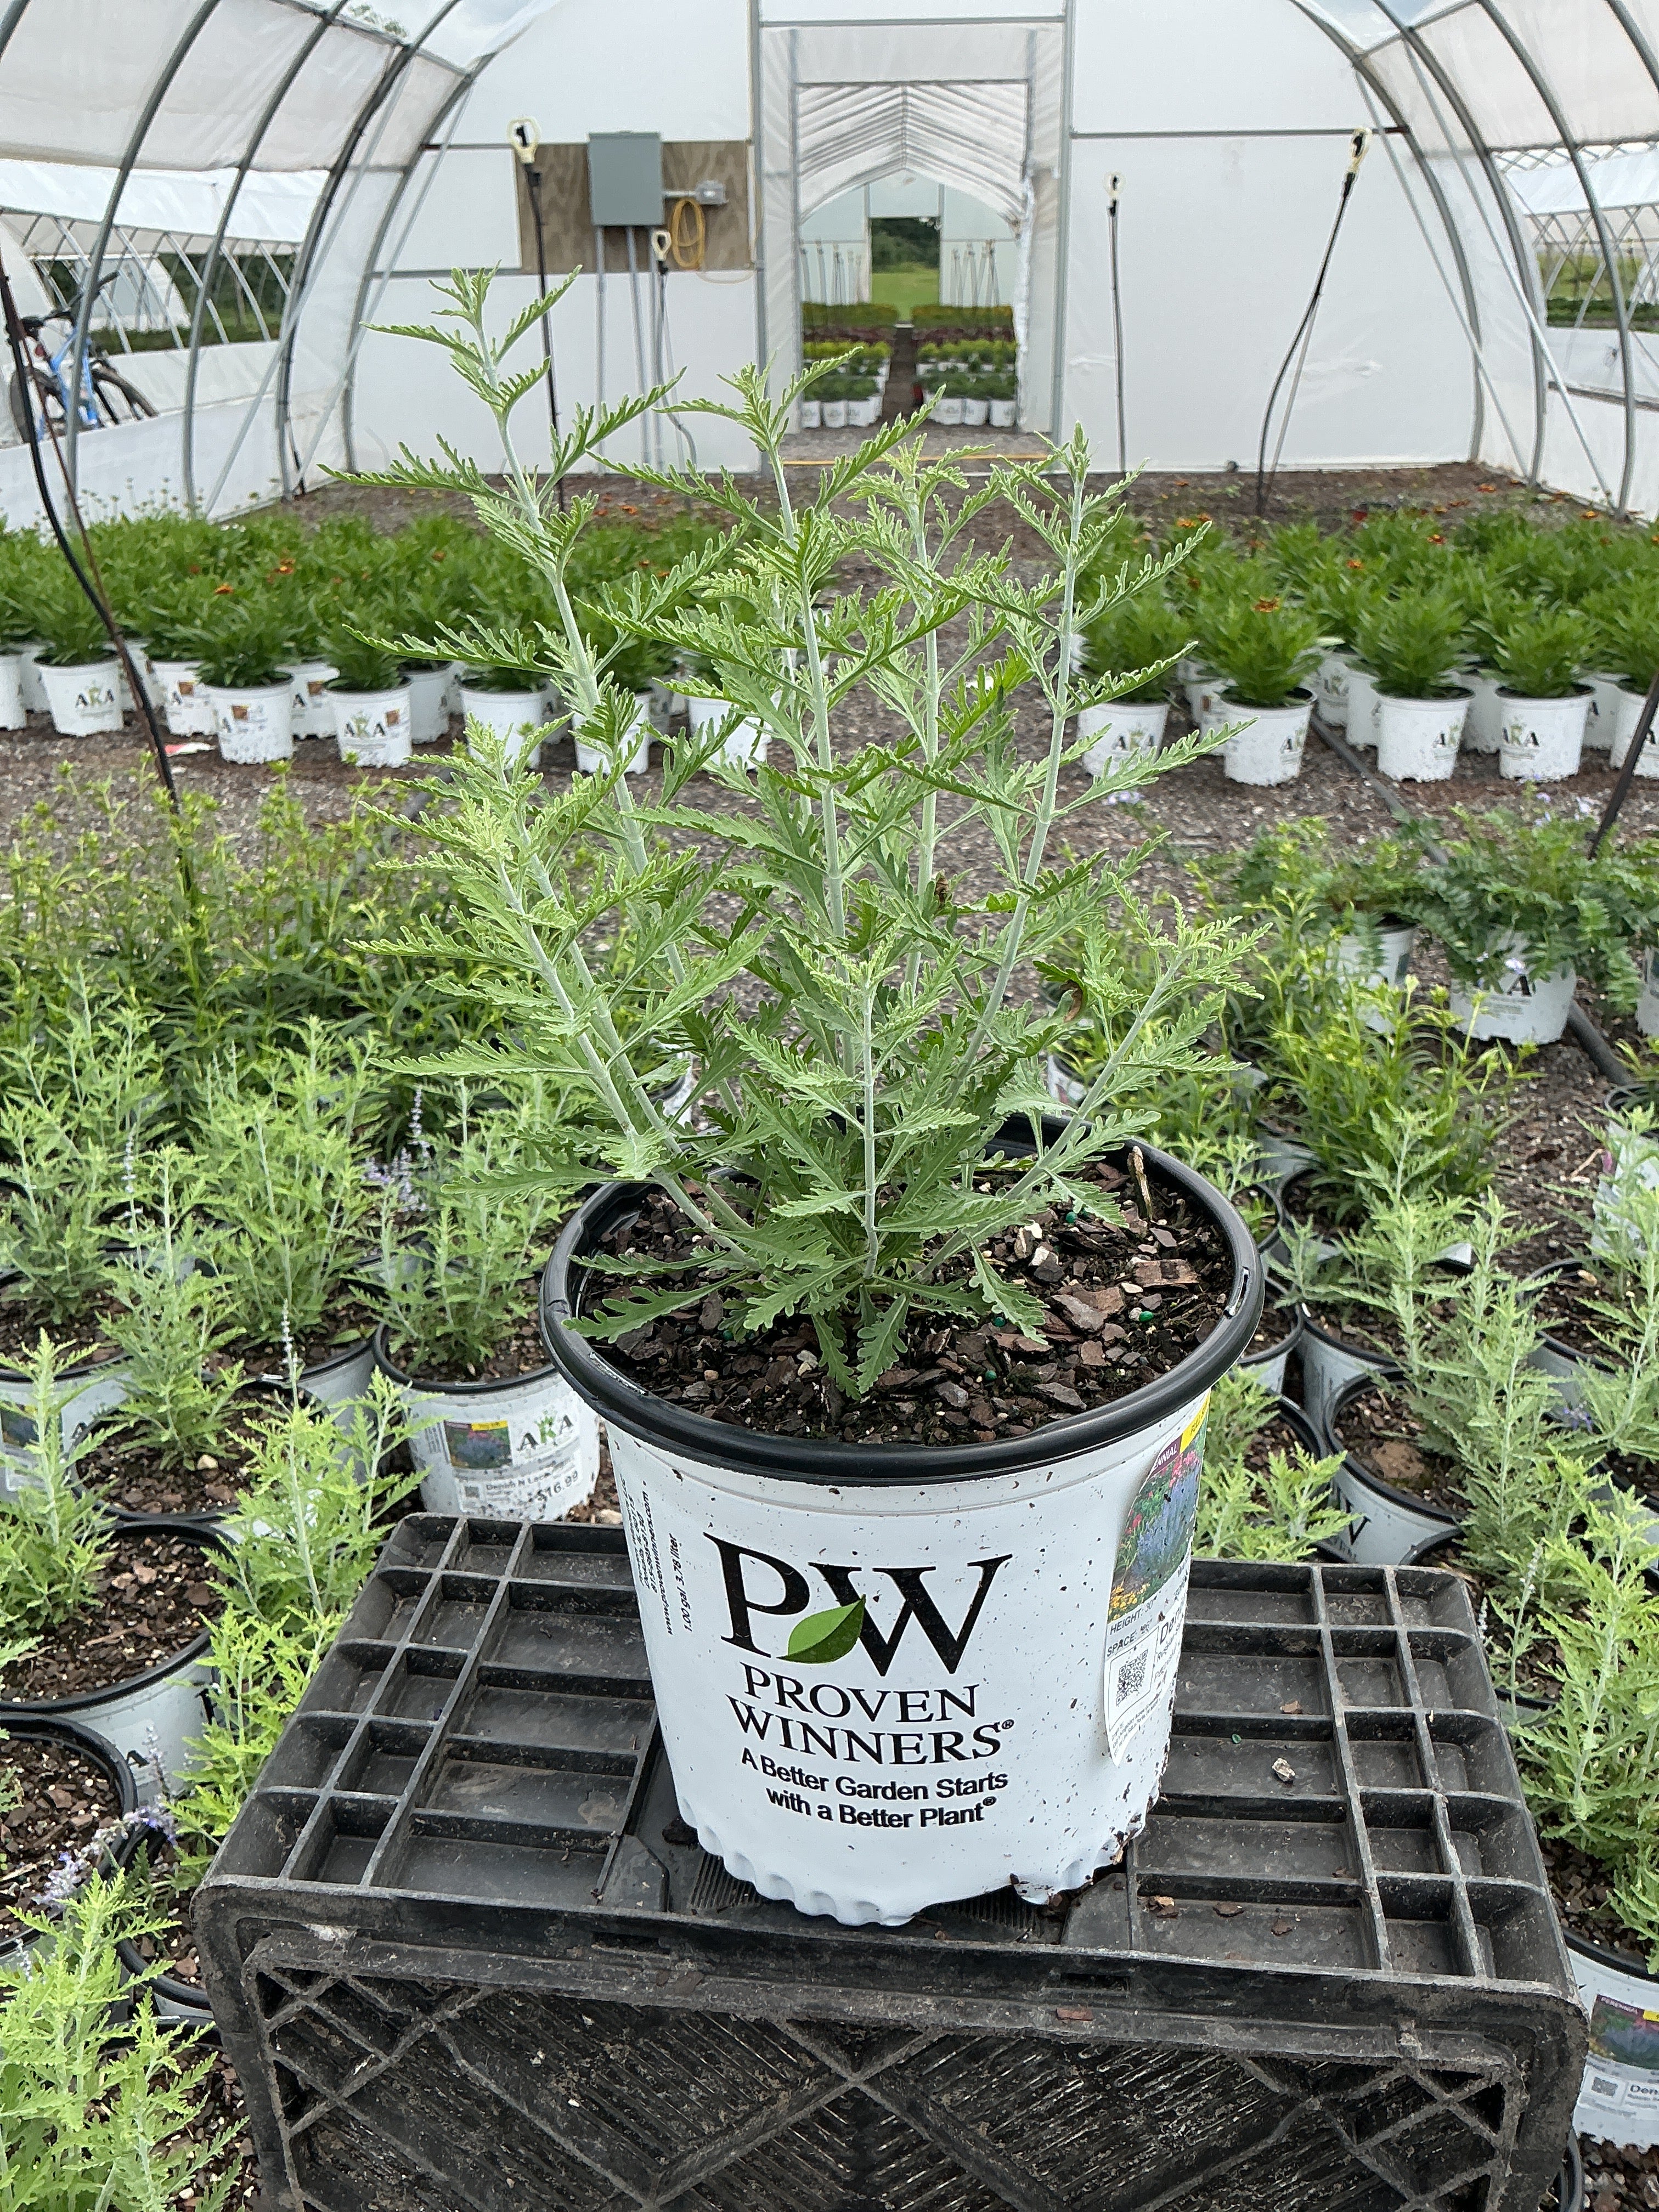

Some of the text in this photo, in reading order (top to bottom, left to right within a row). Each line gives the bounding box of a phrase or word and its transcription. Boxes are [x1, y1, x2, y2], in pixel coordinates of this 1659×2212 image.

[1153, 1443, 1178, 1471] ENNIAL
[642, 1491, 673, 1635] www.provenwinners.com
[668, 1533, 693, 1633] 1.00 gal 3.78 liter
[703, 1531, 1013, 1677] PW
[1110, 1608, 1143, 1635] HEIGHT:
[1107, 1630, 1137, 1657] SPACE:
[740, 1661, 979, 1723] PROVEN
[741, 1747, 1008, 1800] A Better Garden Starts
[766, 1787, 811, 1816] with
[817, 1803, 833, 1821] a
[839, 1803, 913, 1828] Better
